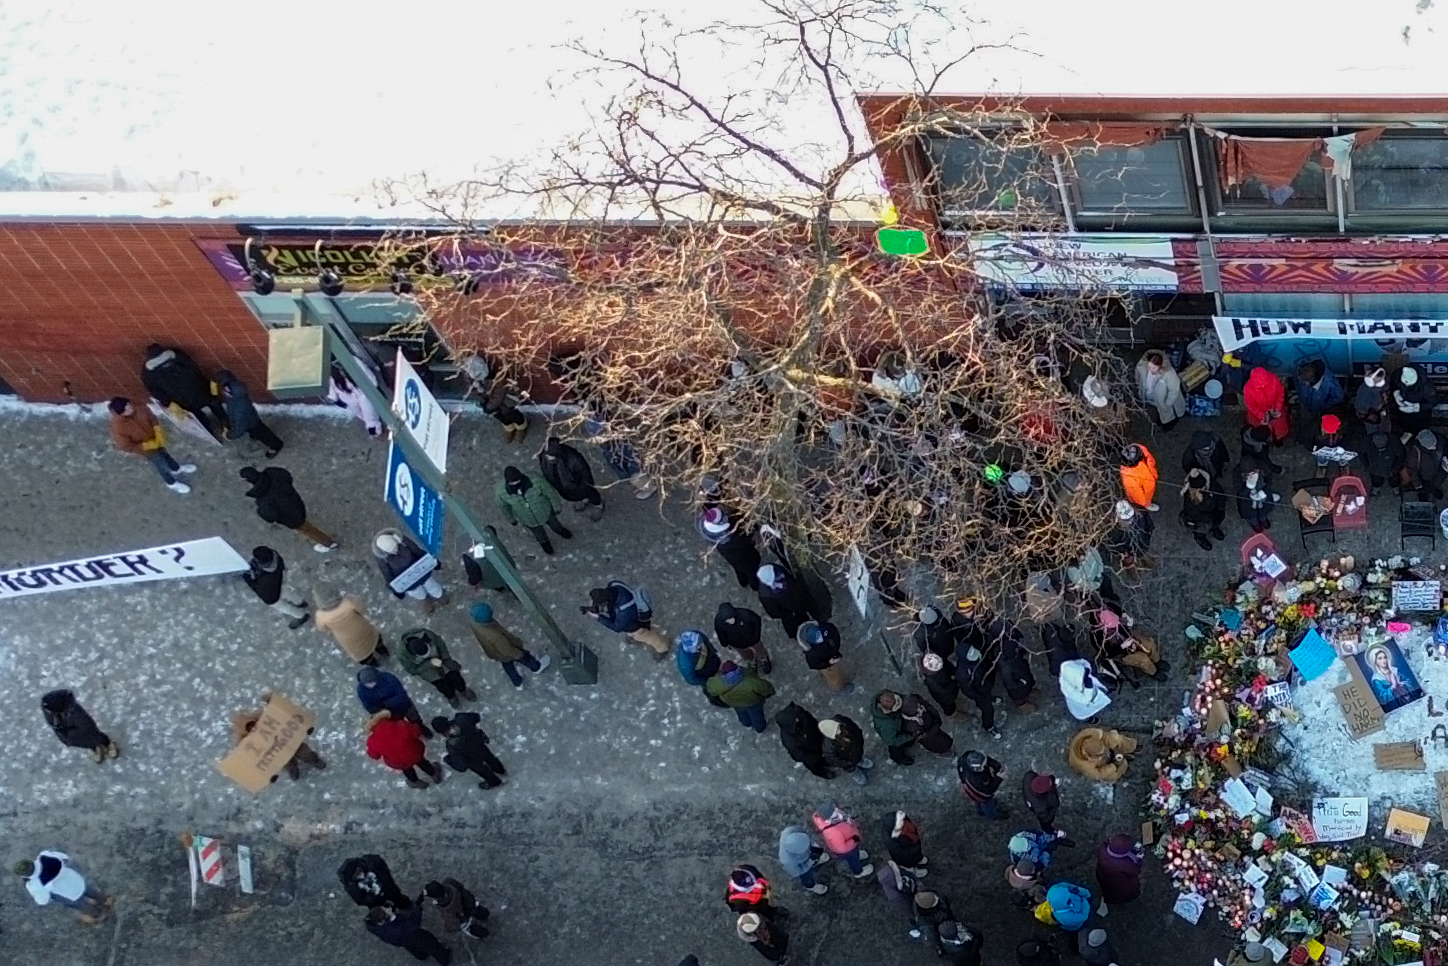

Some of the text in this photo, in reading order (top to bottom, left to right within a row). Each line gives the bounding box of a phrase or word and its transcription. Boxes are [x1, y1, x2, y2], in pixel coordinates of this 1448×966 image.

[1231, 318, 1312, 341] HOW
[1337, 318, 1444, 336] MANY
[1342, 685, 1360, 701] HE
[1353, 707, 1370, 722] NO
[1342, 802, 1362, 817] Good
